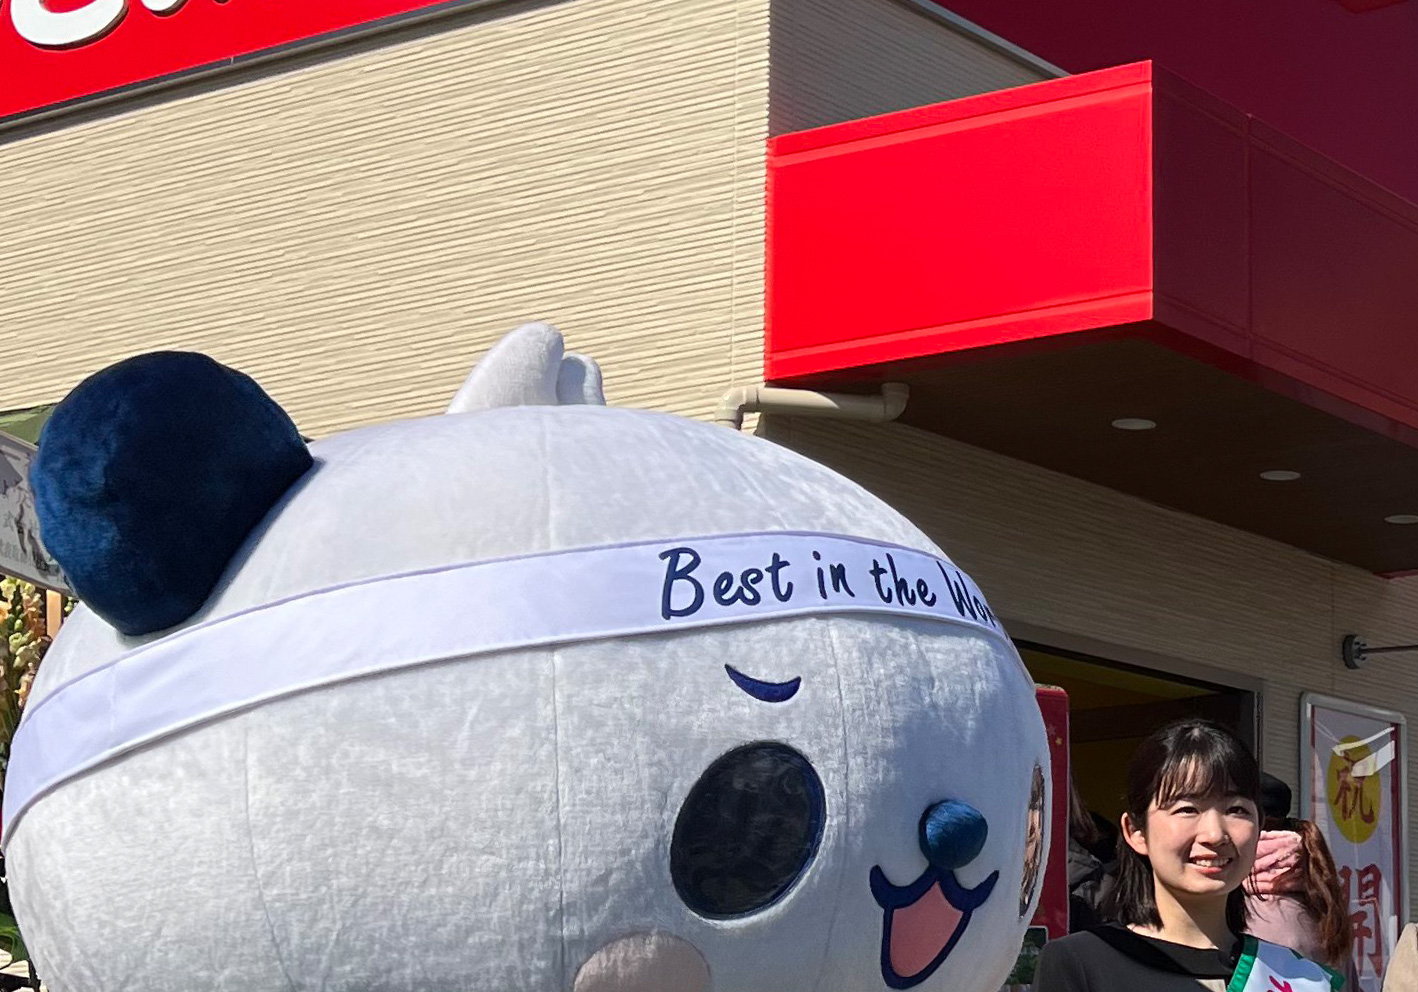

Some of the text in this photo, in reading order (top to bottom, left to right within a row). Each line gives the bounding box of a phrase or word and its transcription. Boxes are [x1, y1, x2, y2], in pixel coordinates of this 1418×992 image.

[658, 547, 794, 620] Best
[812, 550, 855, 600] in
[868, 553, 937, 607] the
[1332, 747, 1376, 825] 祝
